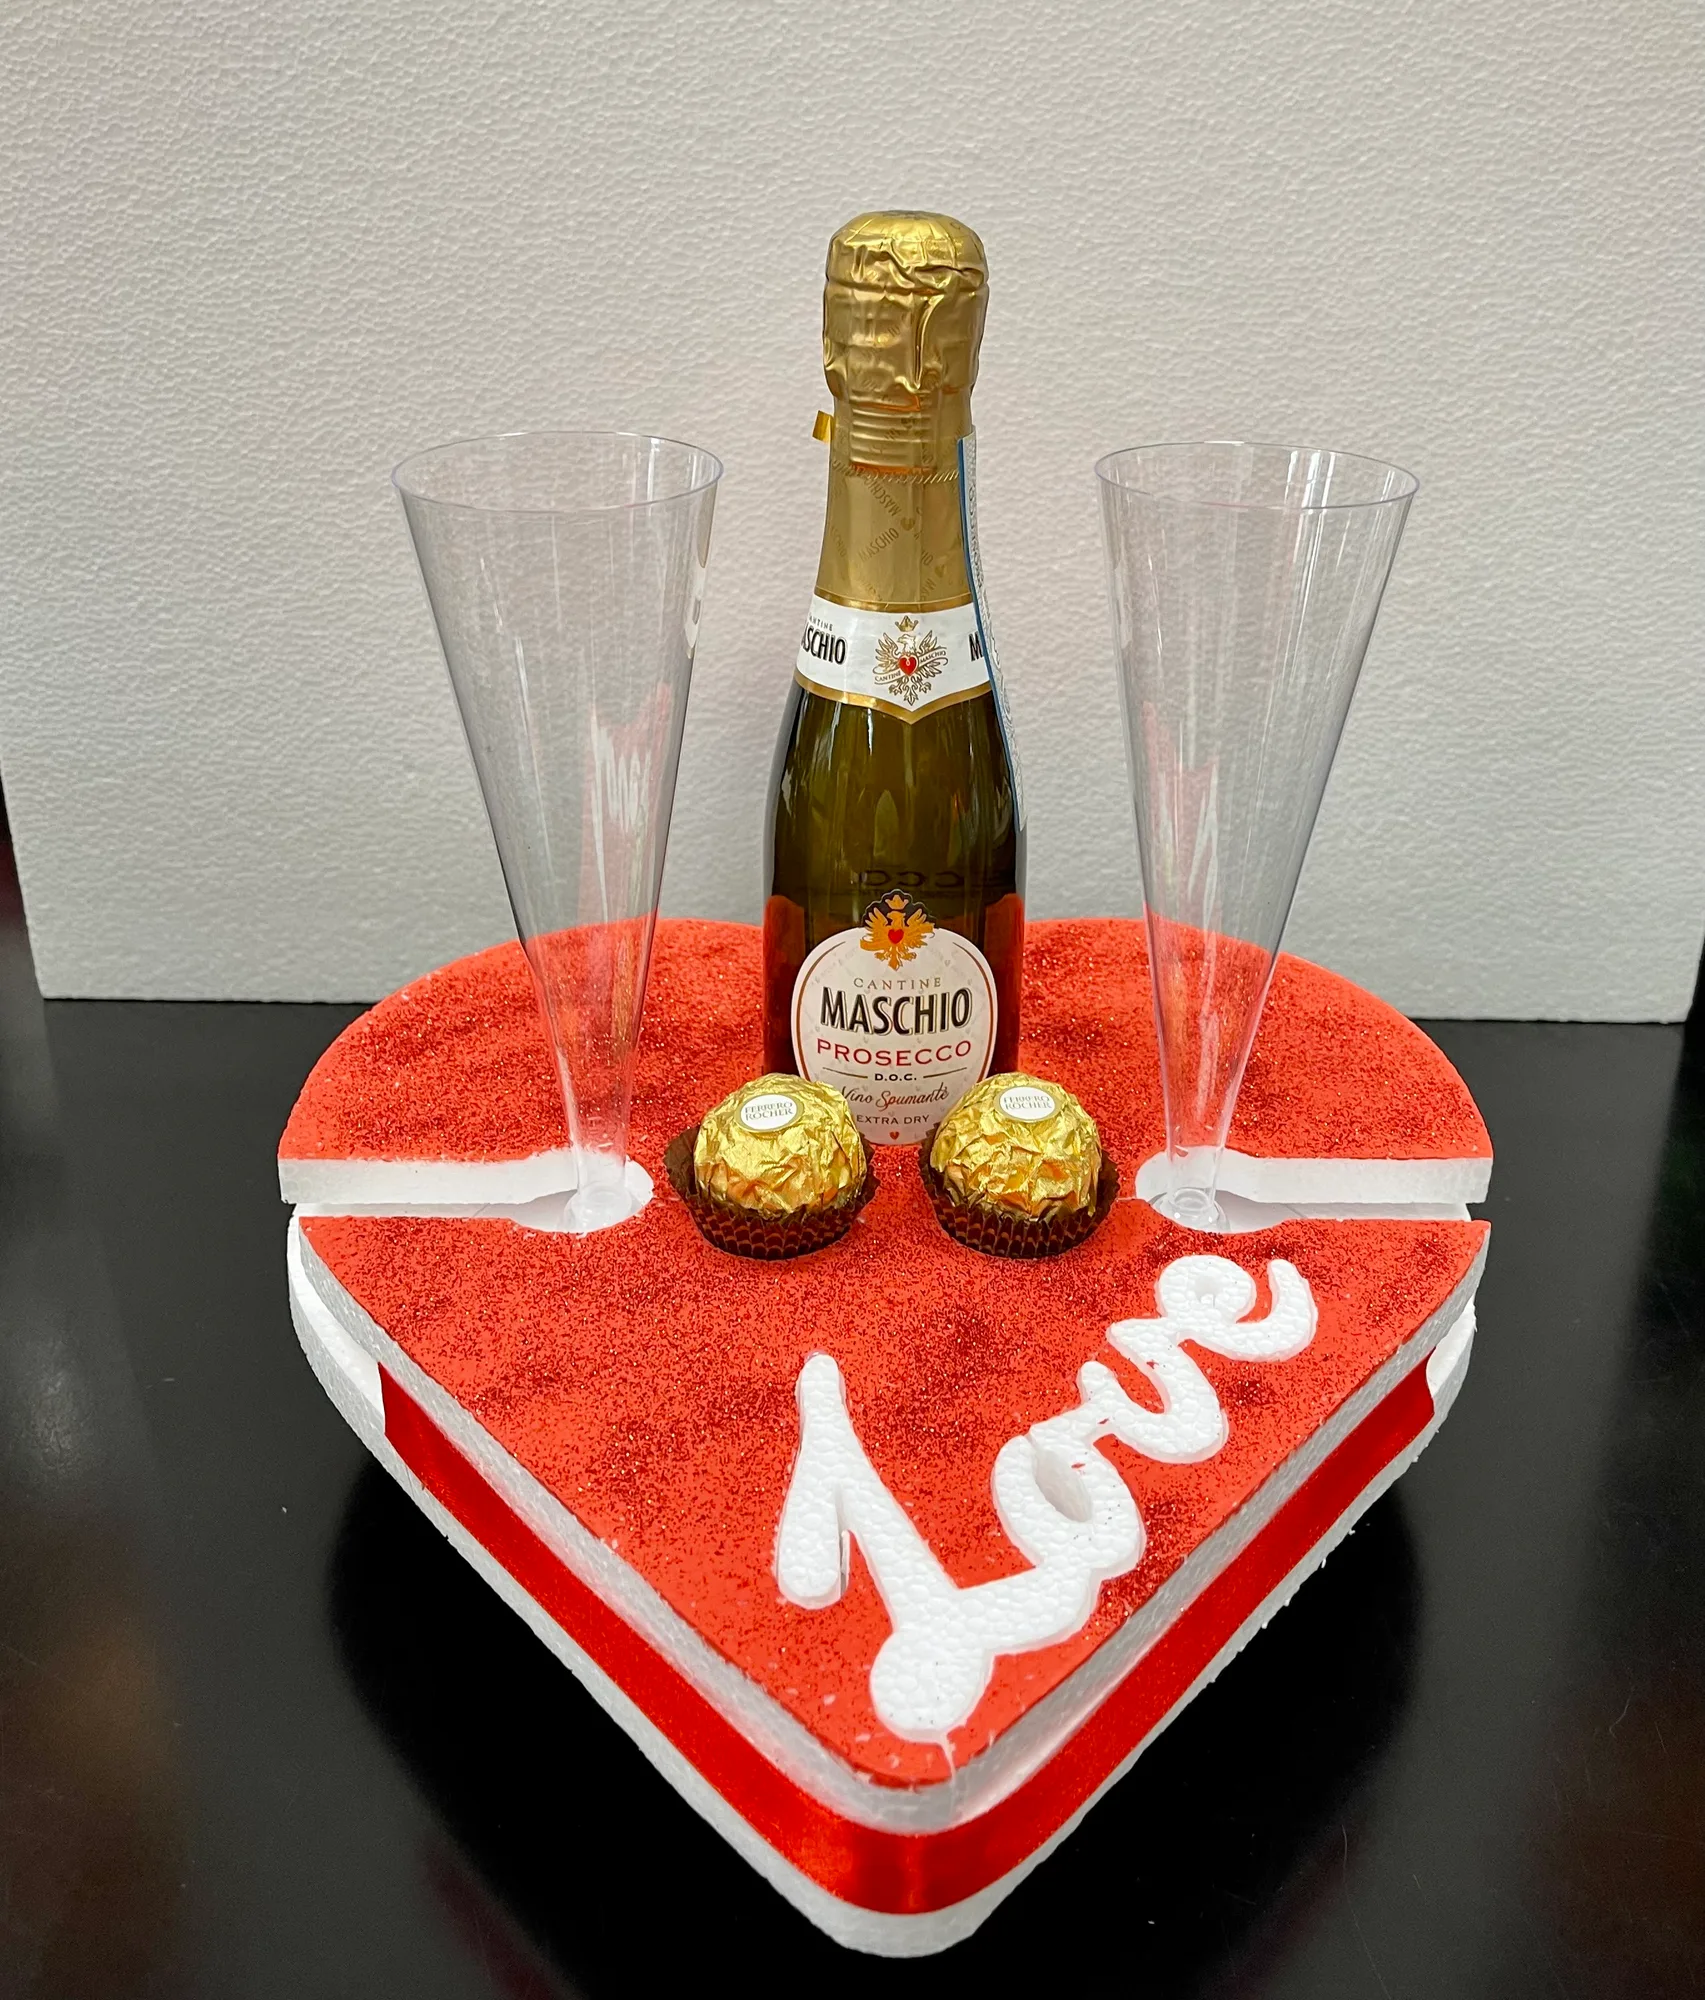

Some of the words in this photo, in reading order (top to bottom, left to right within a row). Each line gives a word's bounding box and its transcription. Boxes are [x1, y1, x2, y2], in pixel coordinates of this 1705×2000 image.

[858, 527, 899, 562] MASCHIO
[853, 977, 942, 991] CANTINE
[820, 986, 973, 1036] MASCHIO
[817, 1038, 972, 1067] PROSECCO
[874, 1073, 917, 1082] D.O.C.
[841, 1086, 873, 1105] Vino
[1003, 1095, 1050, 1103] FERRERO
[745, 1101, 793, 1114] FERRERO
[1005, 1101, 1053, 1110] ROCHER
[745, 1108, 794, 1121] ROCHER
[856, 1115, 900, 1125] EXTRA
[903, 1114, 930, 1124] DRY
